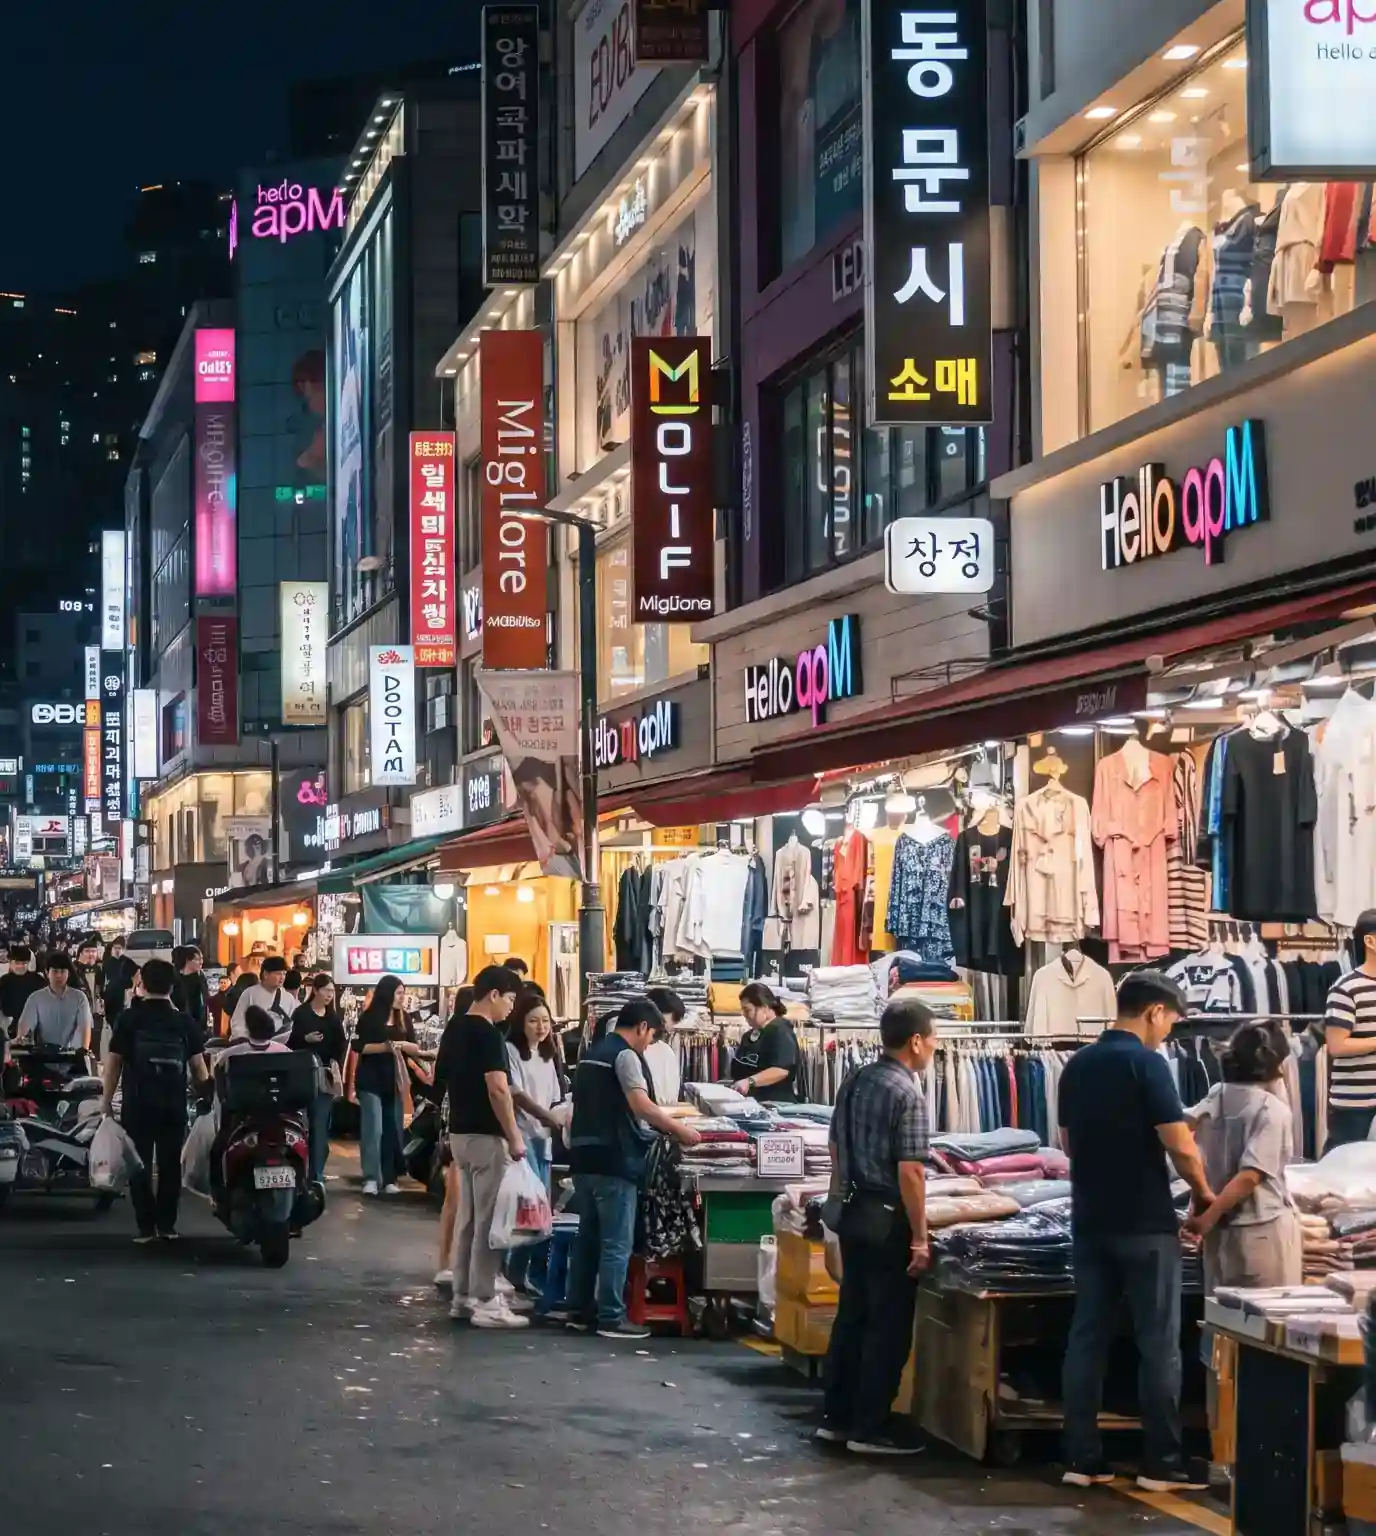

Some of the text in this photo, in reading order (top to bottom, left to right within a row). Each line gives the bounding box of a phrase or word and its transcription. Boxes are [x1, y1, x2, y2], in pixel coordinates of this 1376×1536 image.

[891, 12, 969, 326] 동문시
[888, 358, 977, 406] 소매
[1101, 463, 1176, 570] Hello
[1182, 420, 1259, 565] apM
[744, 614, 853, 726] Hello apM
